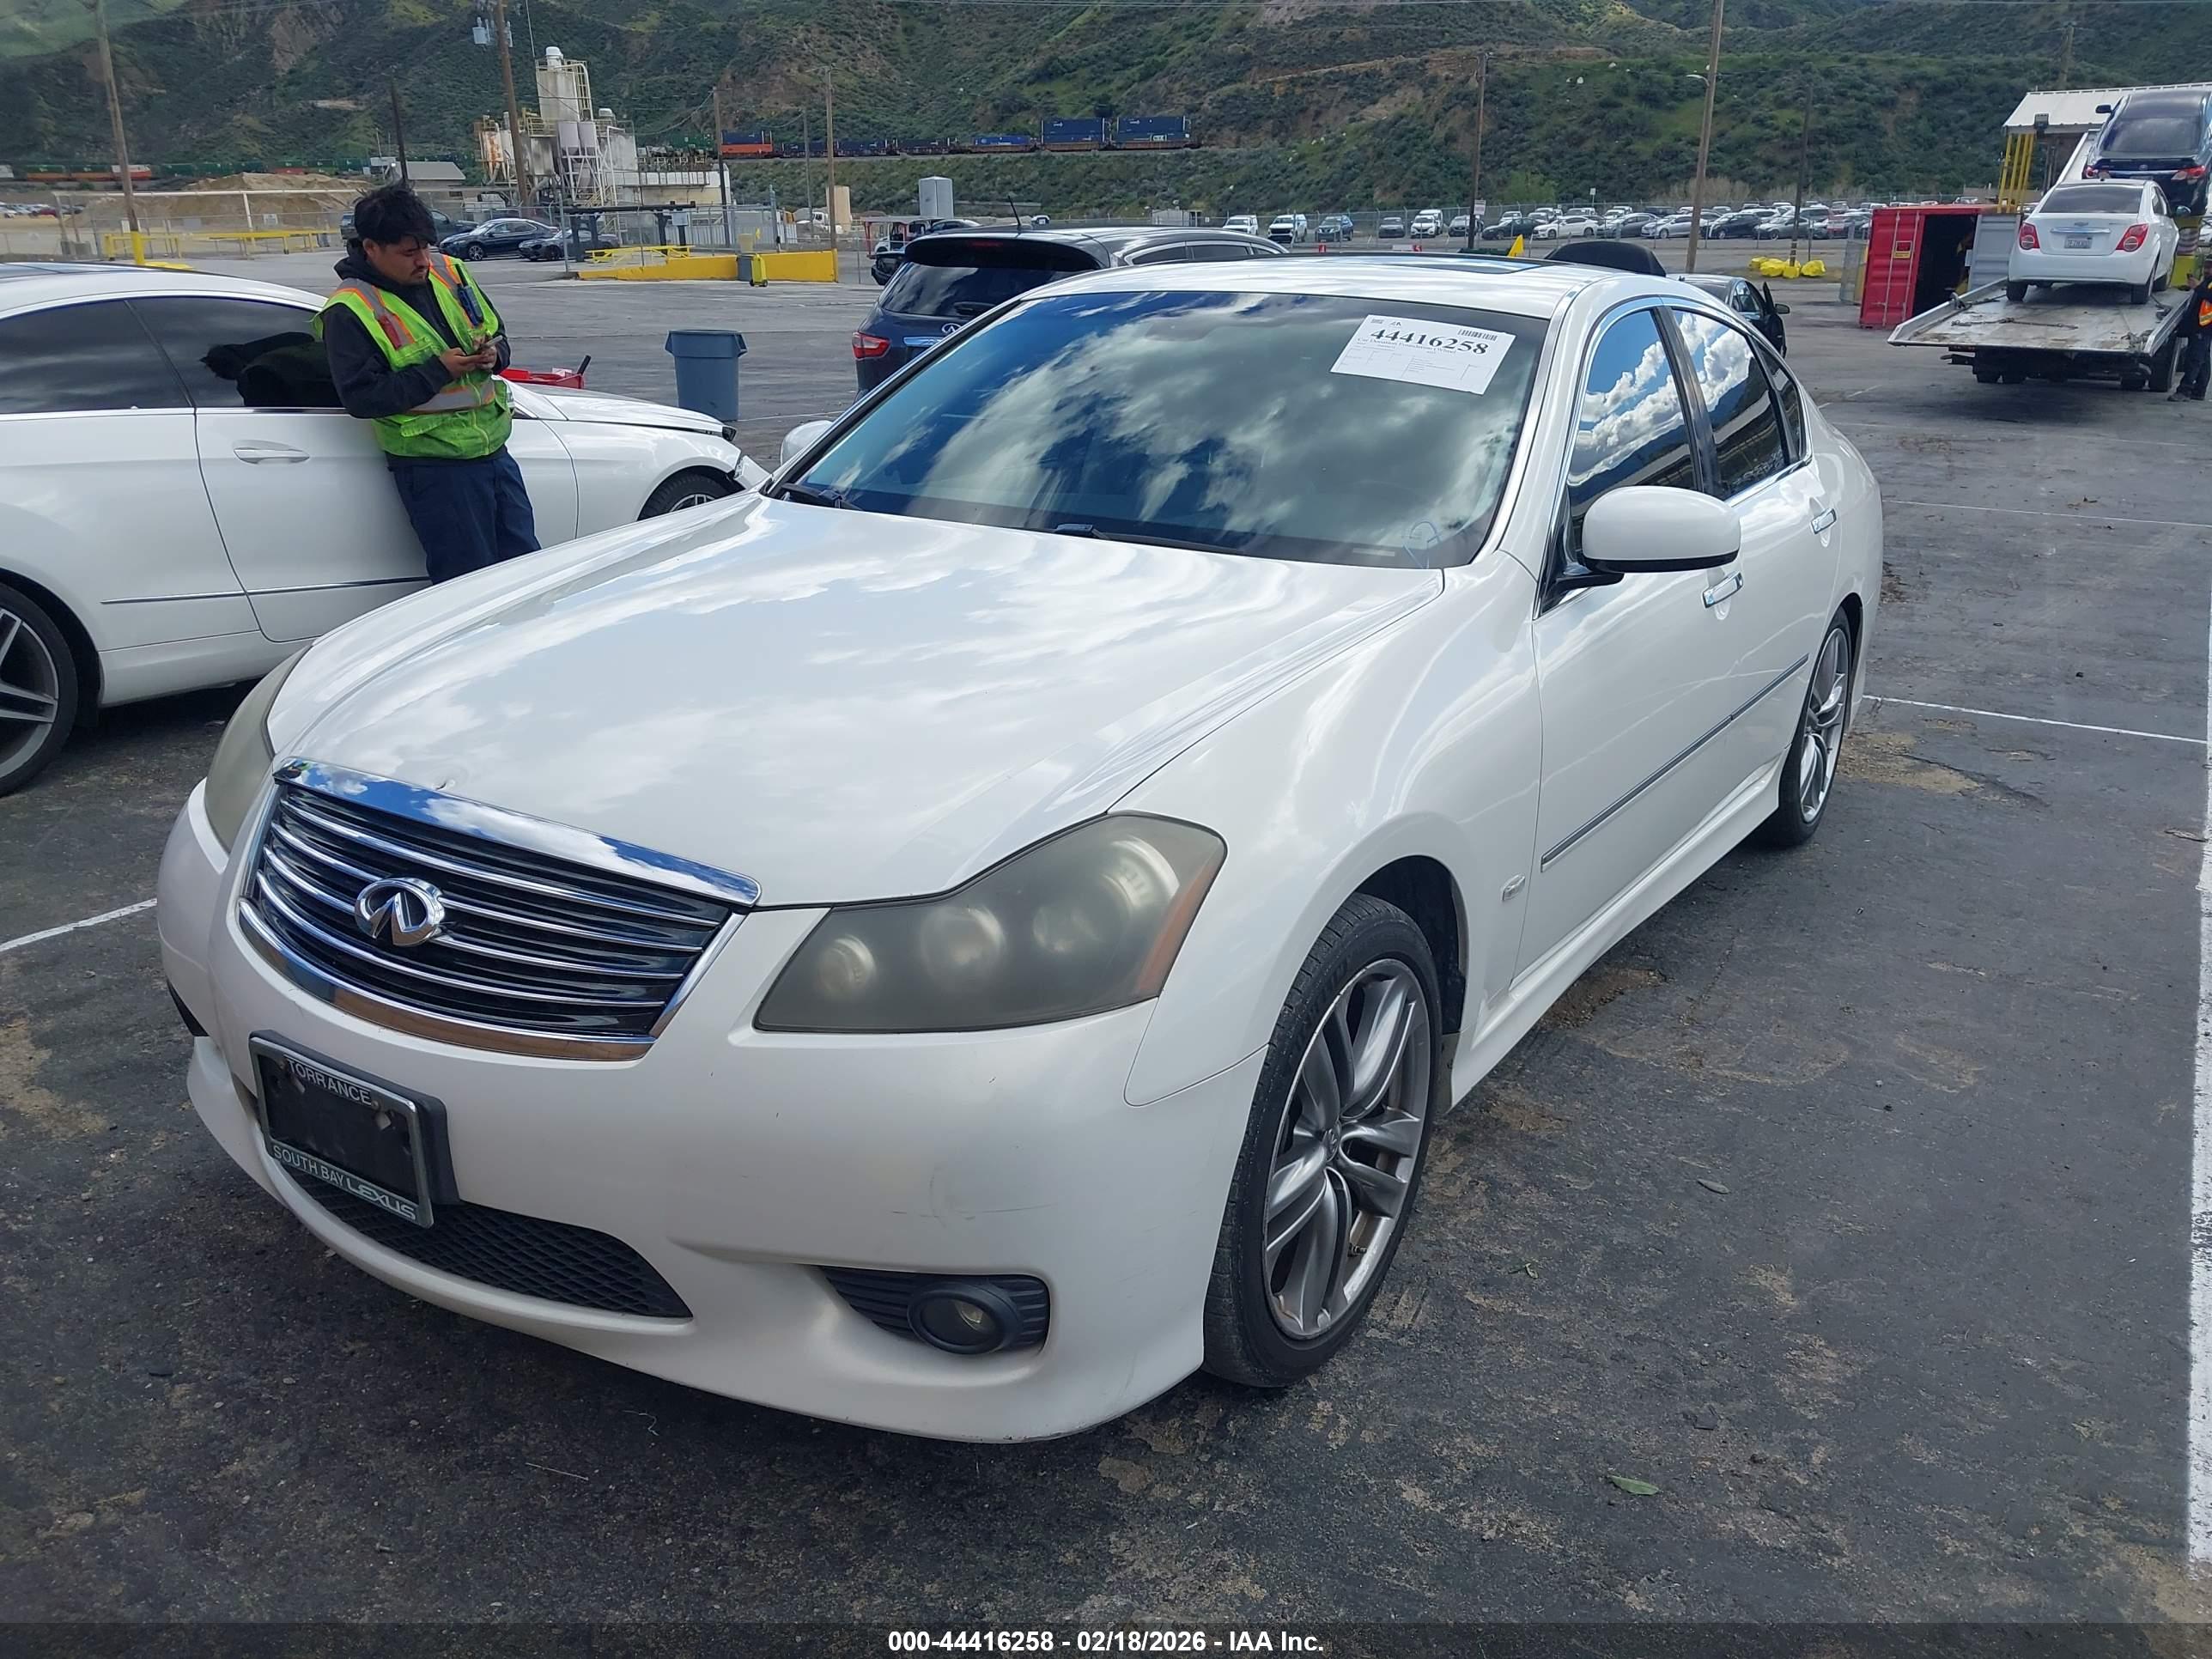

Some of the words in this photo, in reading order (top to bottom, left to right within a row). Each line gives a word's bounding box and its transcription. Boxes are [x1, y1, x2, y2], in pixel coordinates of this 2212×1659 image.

[1370, 329, 1489, 355] 44416258
[288, 1059, 372, 1106] TORRANCE
[273, 1145, 319, 1176] SOUTH
[321, 1165, 343, 1186] BAY
[346, 1178, 416, 1221] LEXUS
